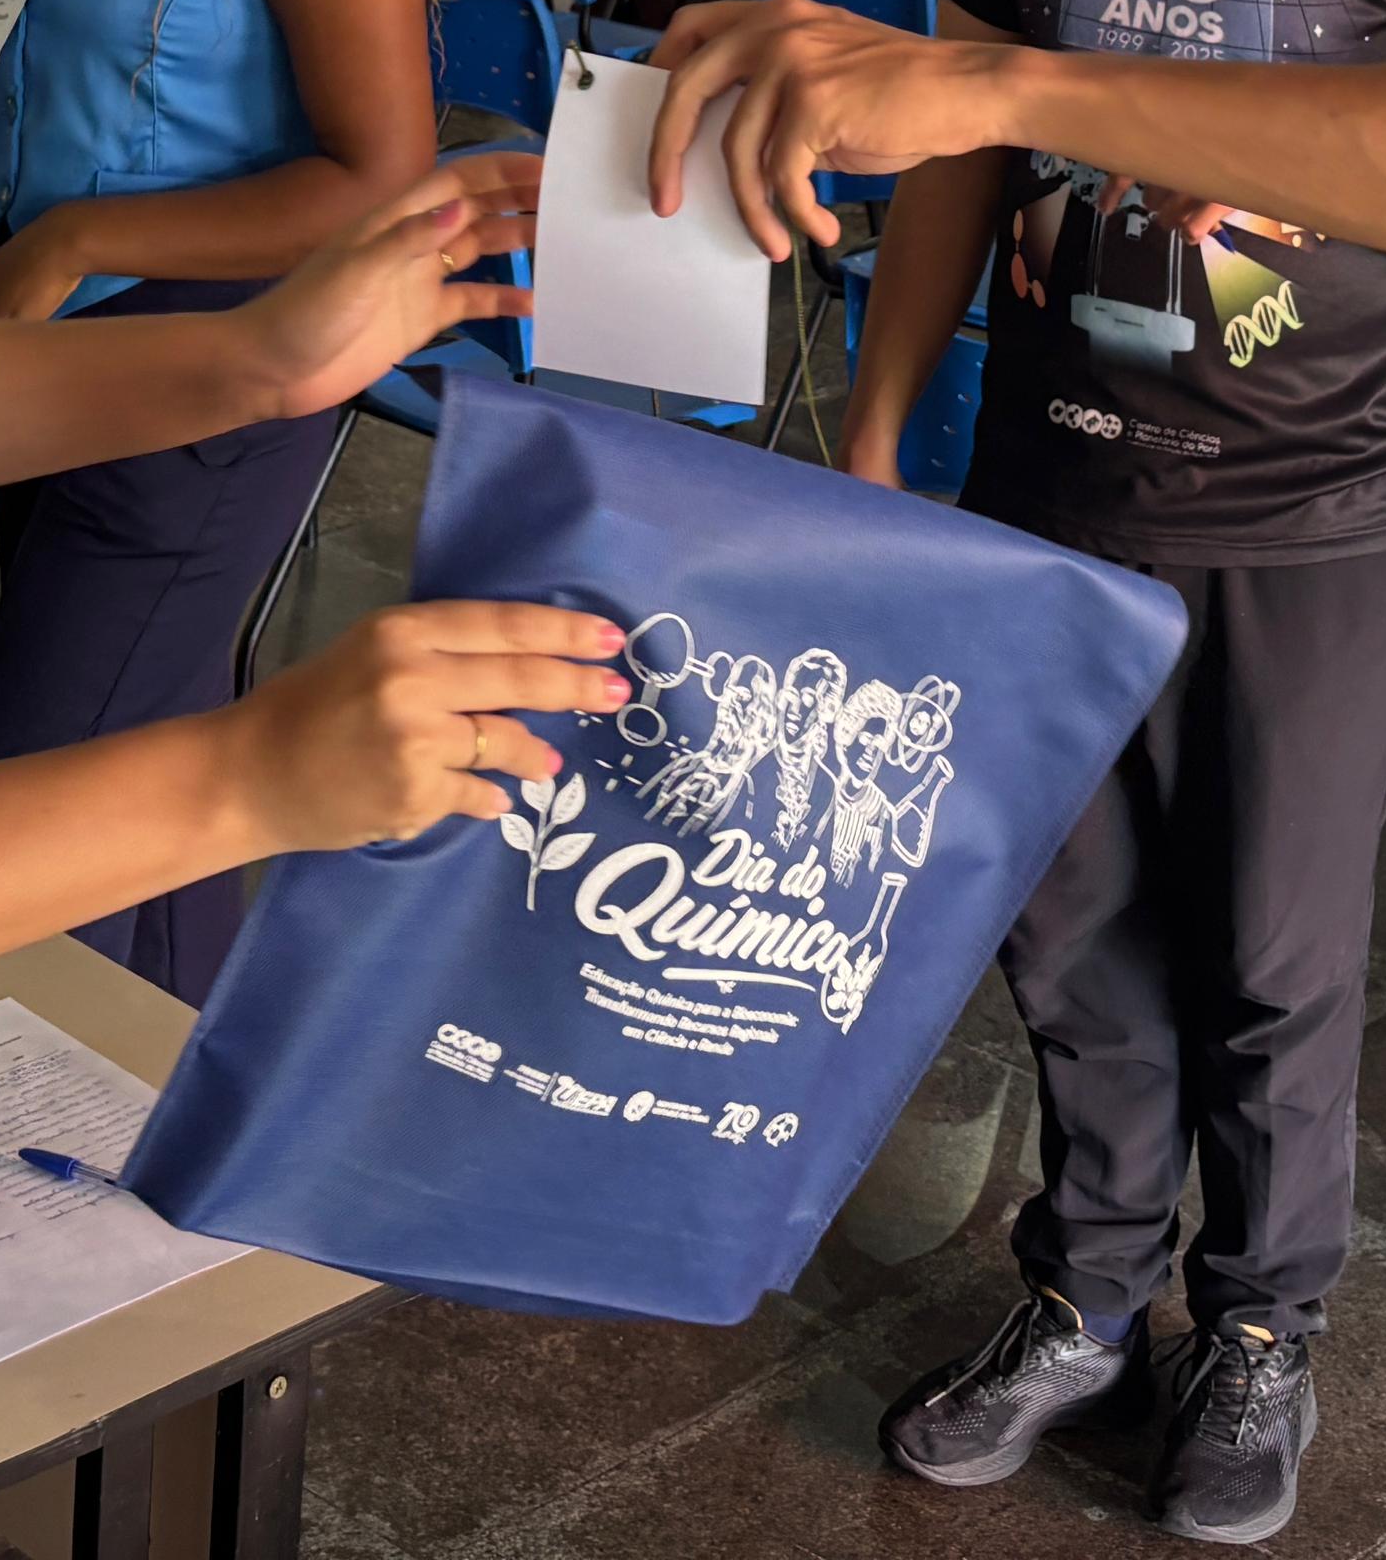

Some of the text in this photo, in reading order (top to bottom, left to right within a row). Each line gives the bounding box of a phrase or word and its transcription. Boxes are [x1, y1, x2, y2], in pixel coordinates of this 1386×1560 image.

[1097, 27, 1145, 51] 1999
[1129, 418, 1222, 445] Centro de Ciências
[691, 829, 827, 900] Dia do
[575, 842, 850, 974] Químico
